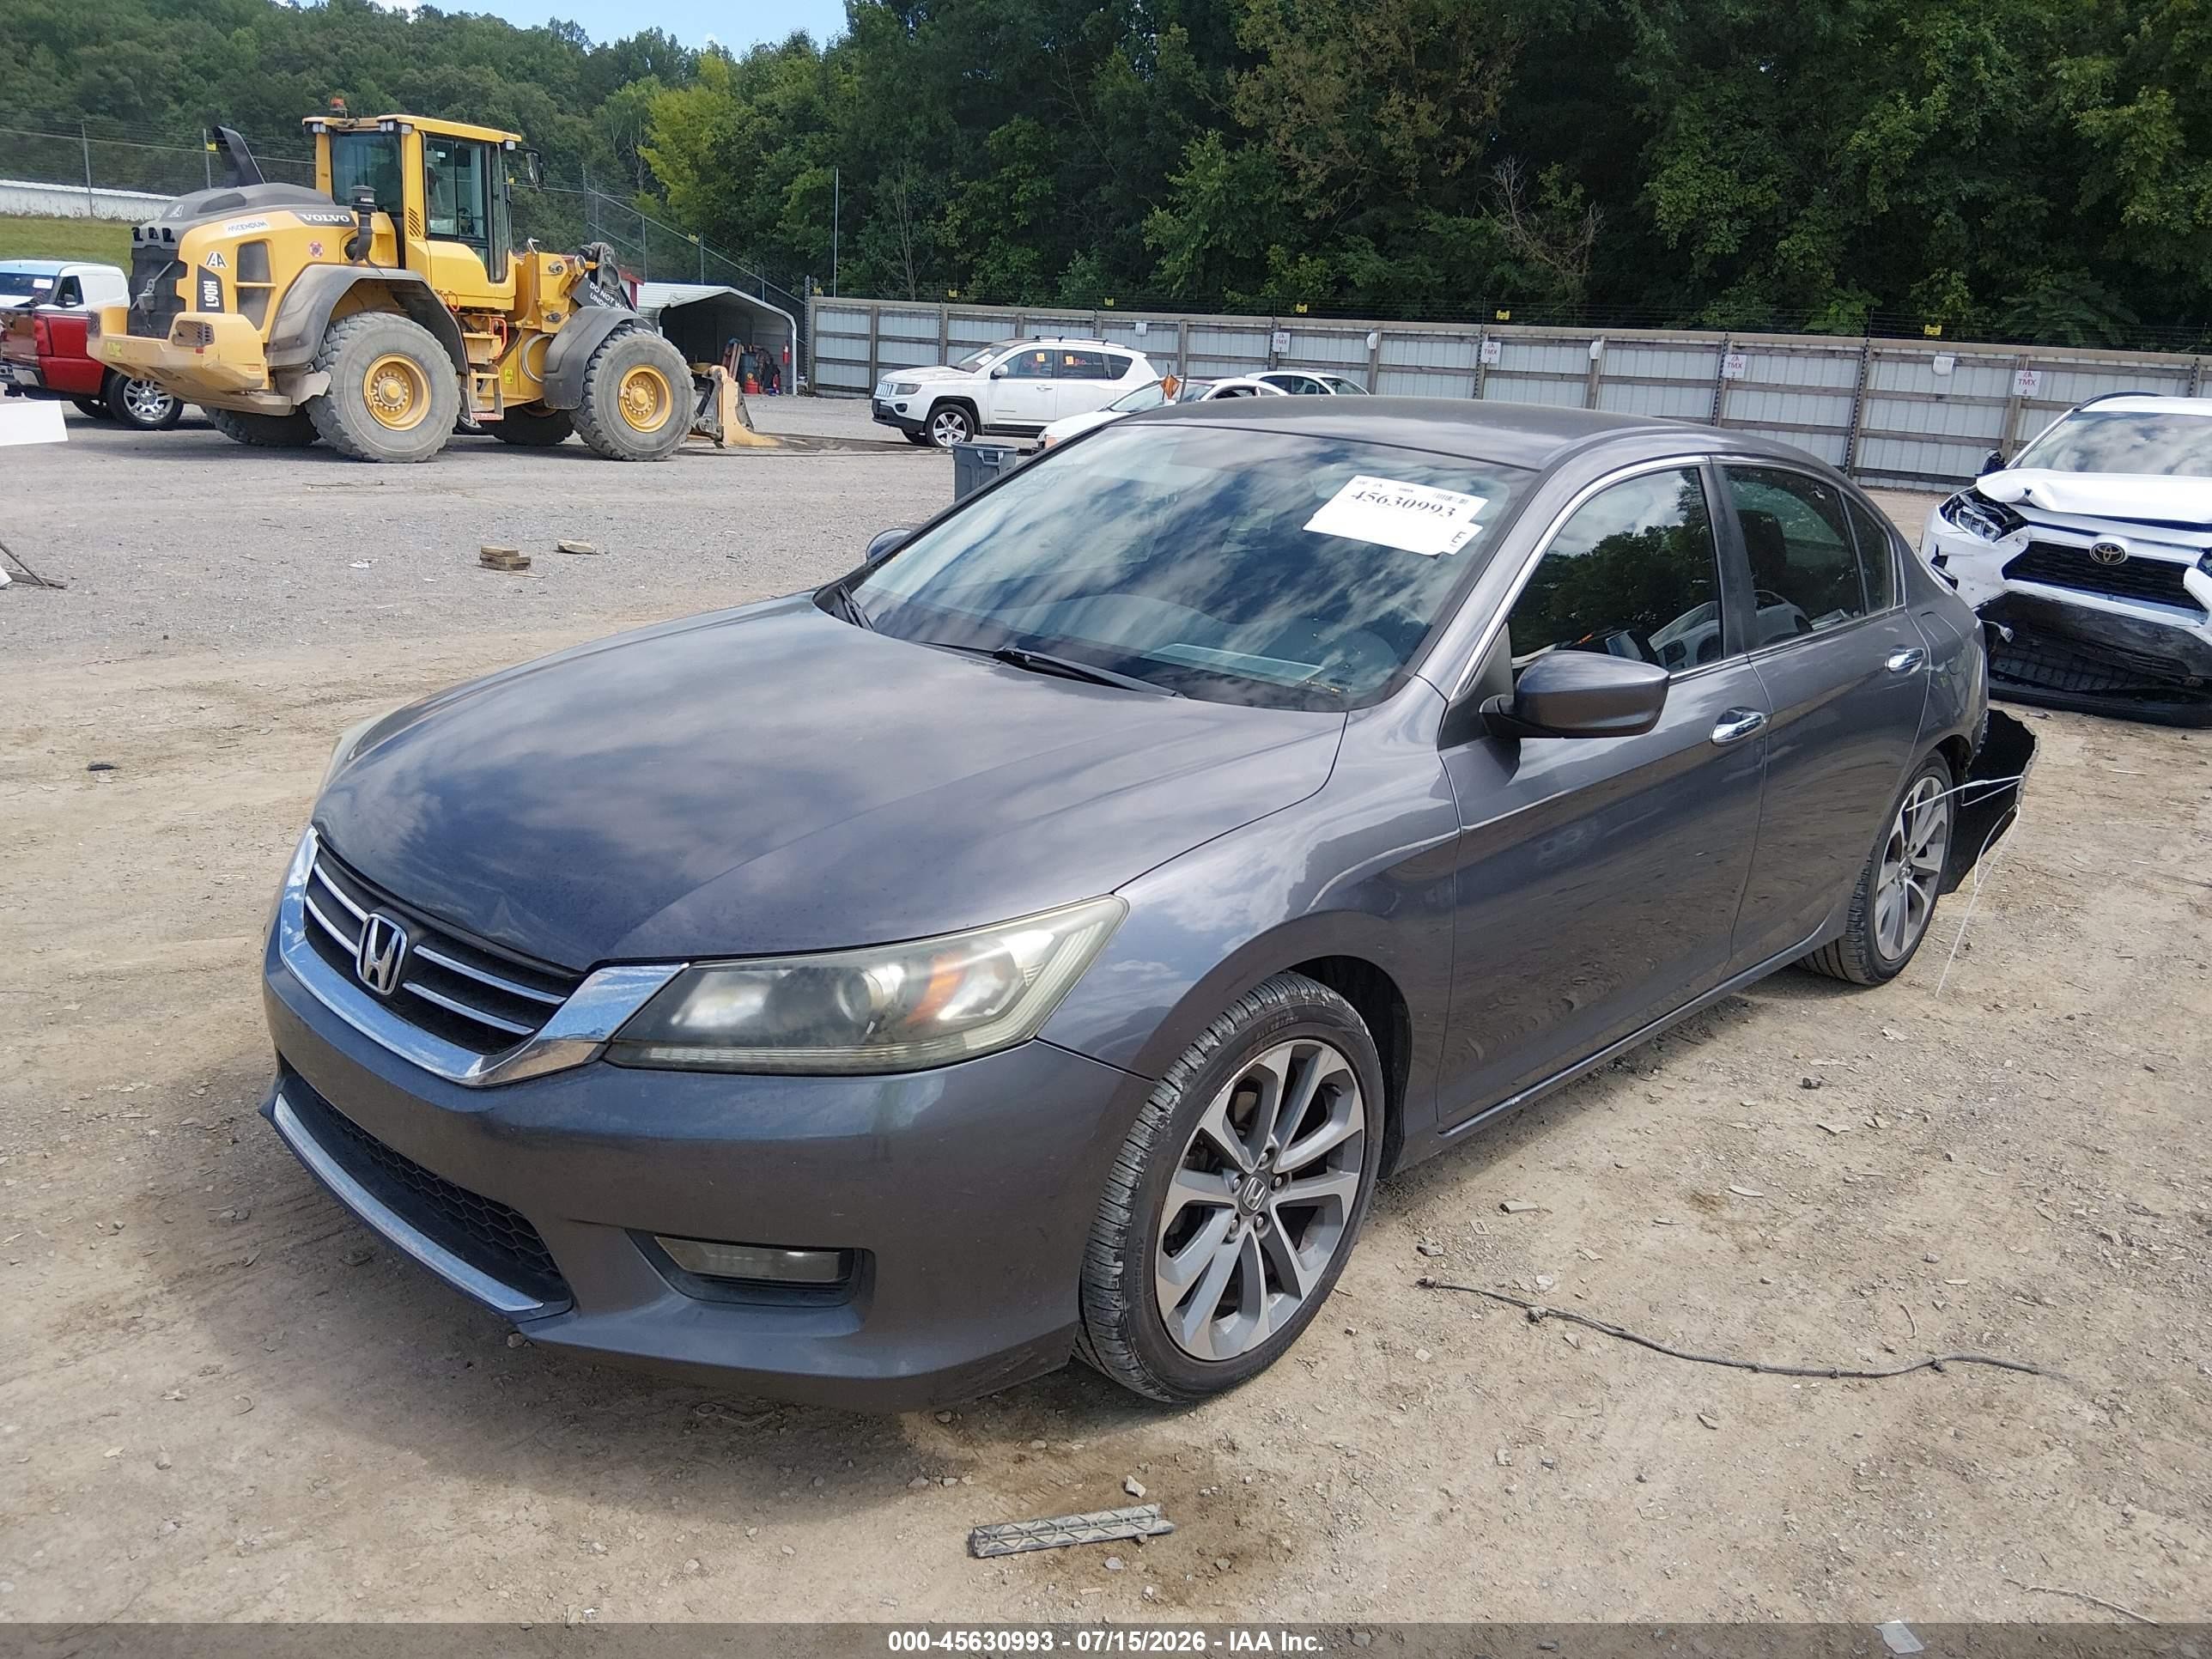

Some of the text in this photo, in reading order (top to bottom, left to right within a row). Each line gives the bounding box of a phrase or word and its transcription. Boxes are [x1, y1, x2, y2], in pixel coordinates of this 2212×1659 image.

[301, 214, 350, 222] VOLVO
[589, 282, 599, 293] DO
[599, 290, 615, 304] NOT
[1351, 490, 1457, 518] 45630993
